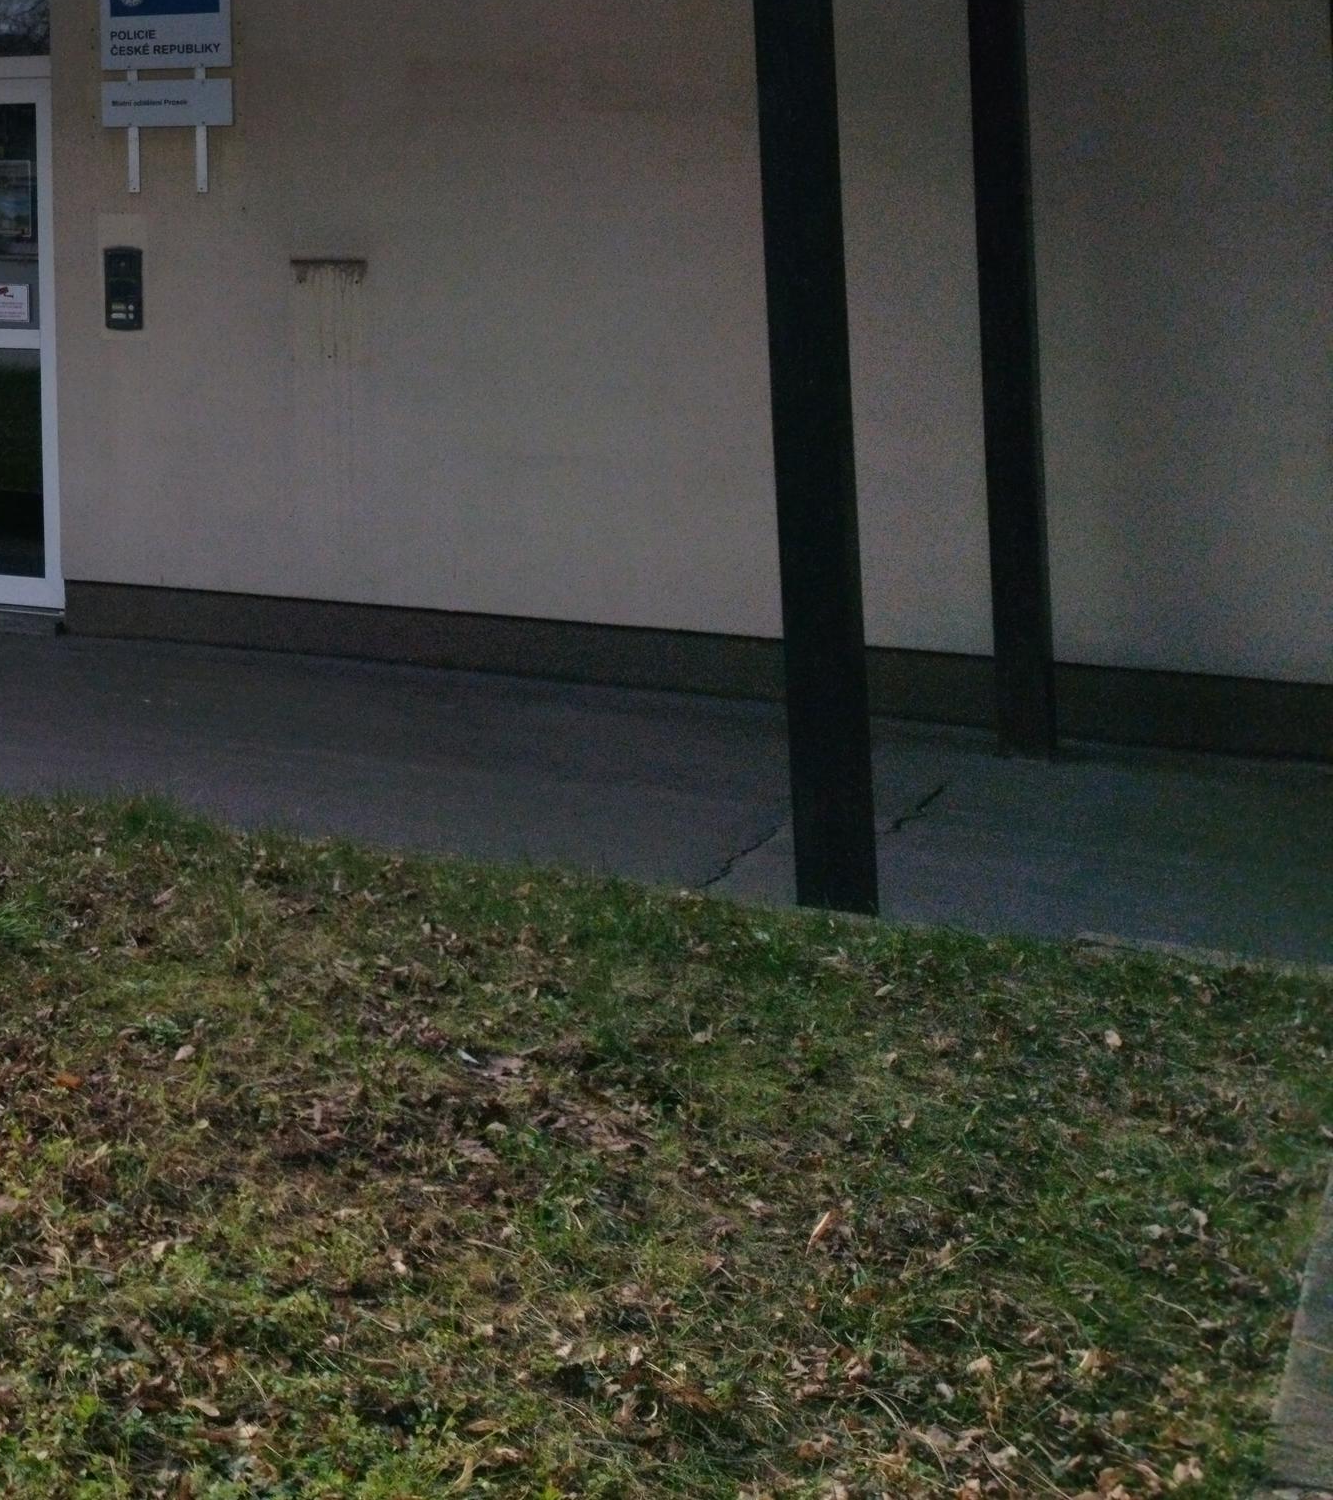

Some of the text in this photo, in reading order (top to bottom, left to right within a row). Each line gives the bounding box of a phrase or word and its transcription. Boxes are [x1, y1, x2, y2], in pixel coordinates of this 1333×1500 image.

[110, 29, 157, 41] POLICIE
[110, 42, 221, 56] ČESKÉ REPUBLIKY
